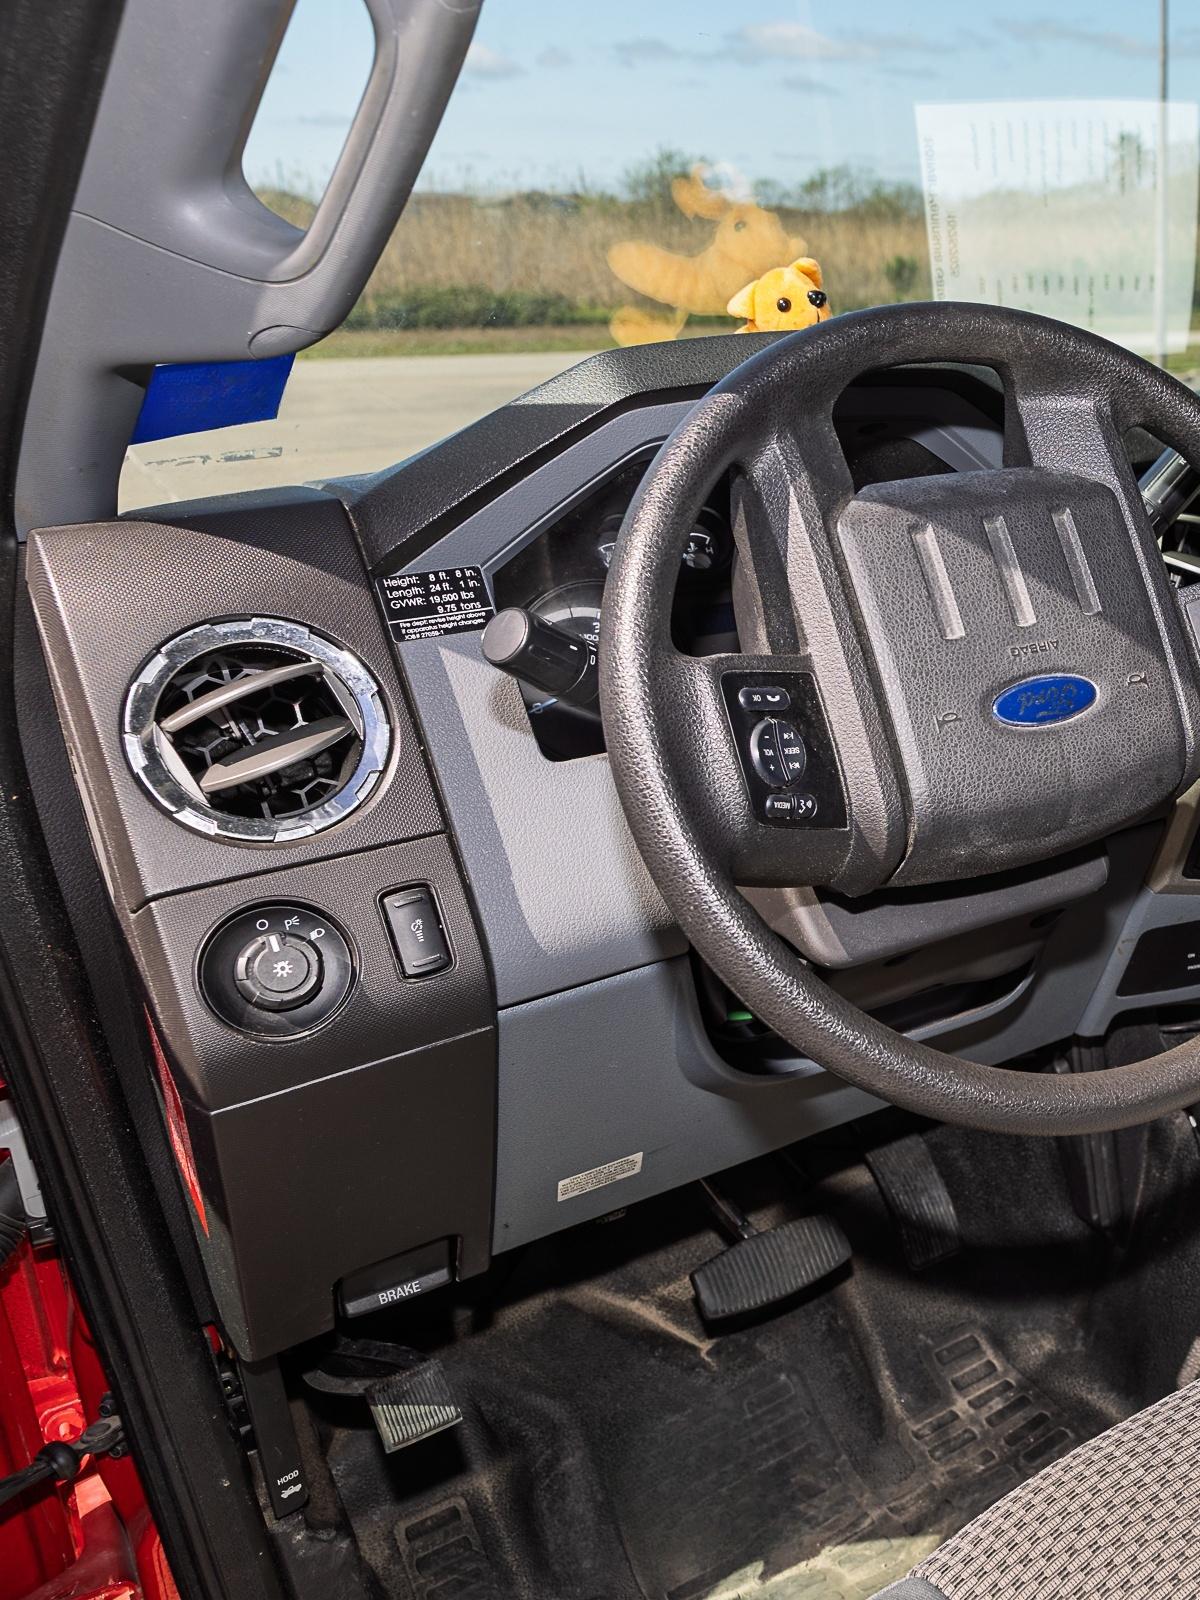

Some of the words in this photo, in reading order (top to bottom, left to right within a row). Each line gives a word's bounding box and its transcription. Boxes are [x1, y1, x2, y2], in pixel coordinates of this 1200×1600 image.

[383, 577, 420, 588] Height:
[428, 573, 436, 582] 8
[439, 572, 450, 581] ft.
[455, 569, 462, 578] 8
[465, 568, 477, 577] in.
[386, 587, 426, 599] Length:
[429, 584, 441, 593] 24
[442, 582, 453, 591] ft.
[468, 579, 481, 588] in.
[390, 598, 427, 609] GVWR:
[429, 593, 459, 605] 19,500
[460, 590, 475, 600] lbs
[436, 603, 457, 614] 9.75
[460, 600, 482, 611] tons
[1010, 640, 1059, 657] AIRBAG
[752, 694, 762, 702] OK
[783, 746, 800, 755] SEEK
[774, 801, 790, 809] MEDIA
[378, 1280, 422, 1305] BRAKE
[277, 1469, 299, 1486] HOOD
